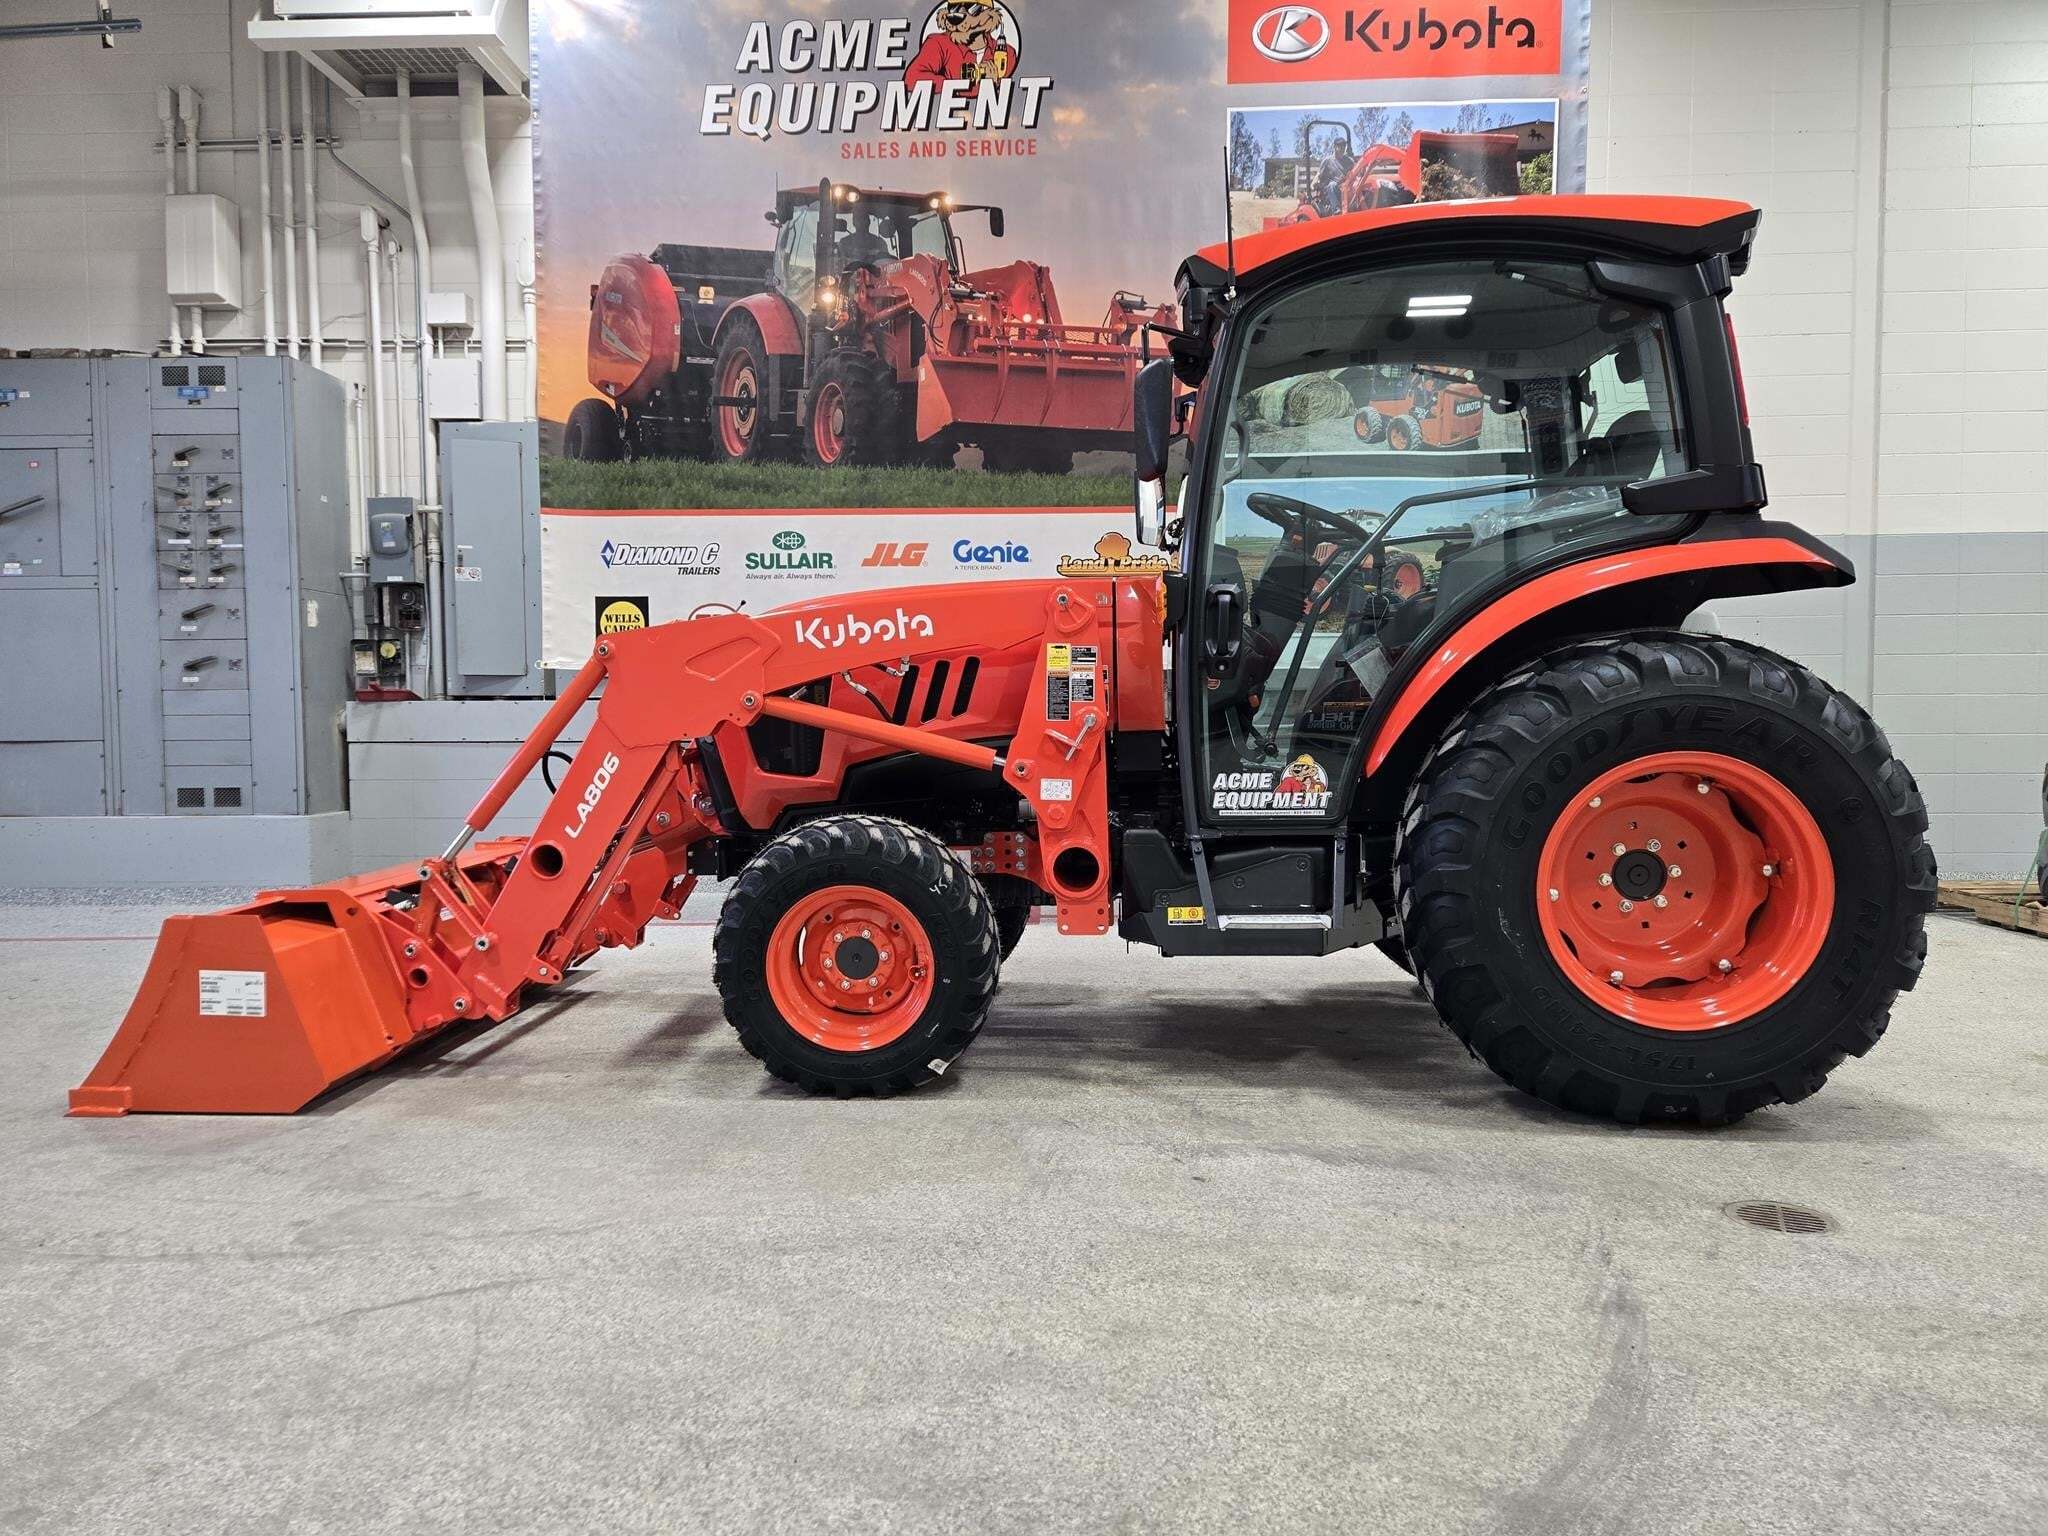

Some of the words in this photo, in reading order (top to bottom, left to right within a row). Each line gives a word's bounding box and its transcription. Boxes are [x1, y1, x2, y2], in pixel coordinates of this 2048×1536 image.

[1345, 6, 1536, 52] Kubota
[735, 18, 912, 74] ACME
[700, 77, 1053, 139] EQUIPMENT
[841, 142, 901, 160] SALES
[908, 140, 947, 158] AND
[956, 138, 1037, 158] SERVICE
[1456, 401, 1481, 414] KUBOTA
[611, 543, 698, 565] DIAMOND
[701, 542, 721, 565] C
[745, 552, 834, 569] SULLAIR
[861, 543, 929, 567] JLG
[953, 539, 1029, 563] Genie
[678, 566, 720, 576] TRAILERS
[1060, 555, 1106, 571] Land
[1119, 555, 1168, 571] Pride
[604, 614, 640, 623] WELLS
[795, 607, 935, 650] Kubota
[1212, 772, 1274, 791] ACME
[564, 751, 620, 839] LA806
[1212, 791, 1333, 810] EQUIPMENT
